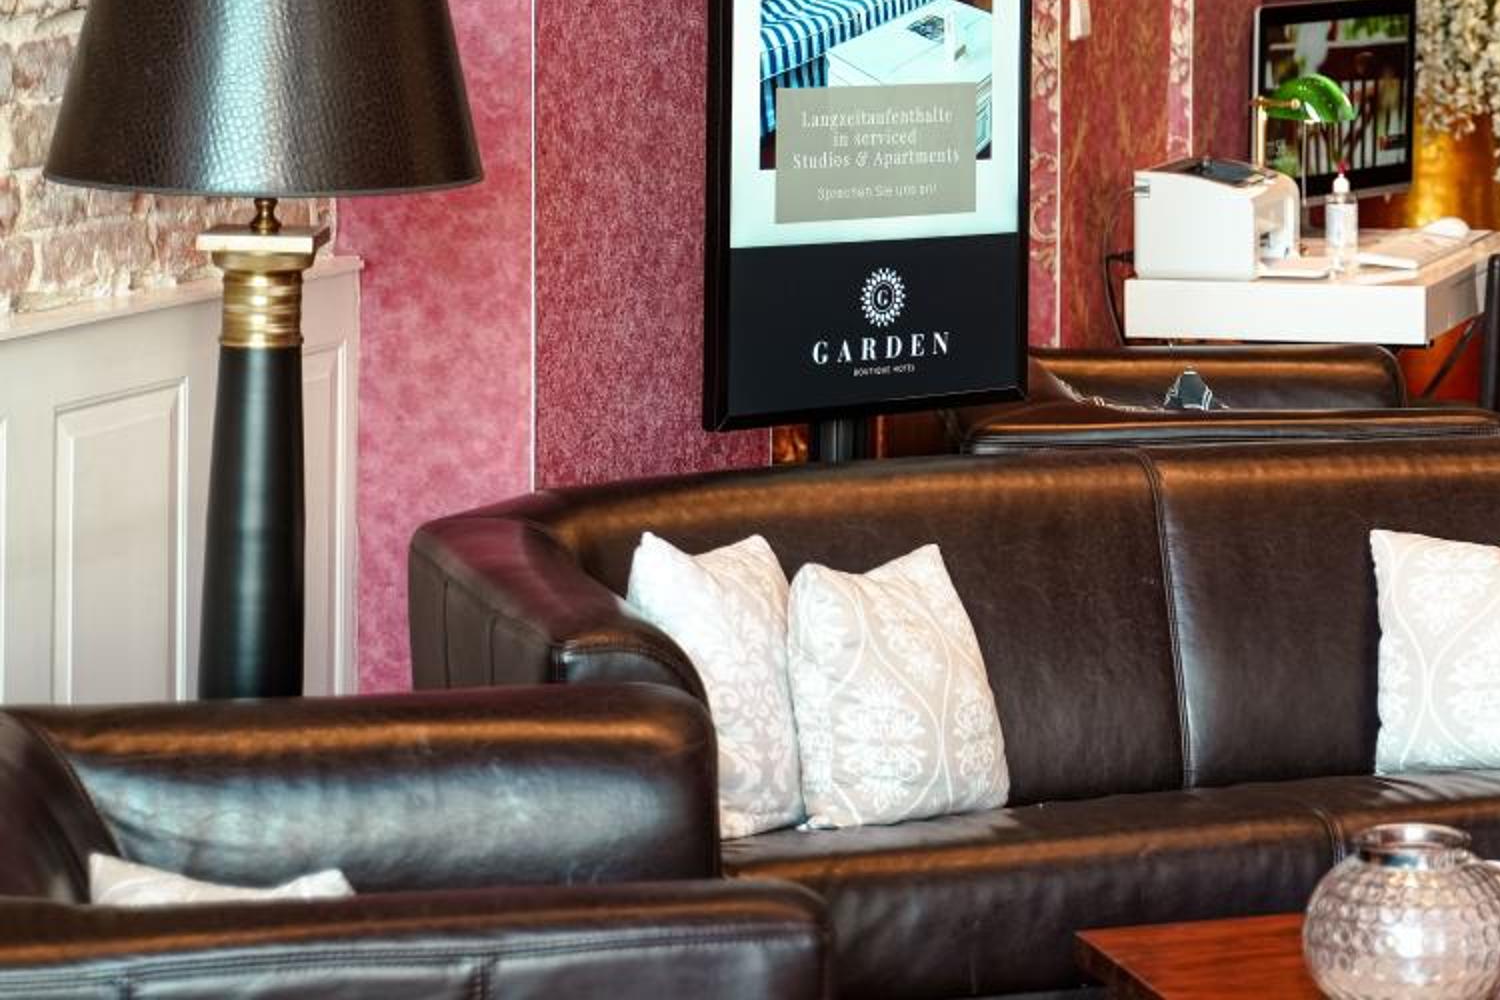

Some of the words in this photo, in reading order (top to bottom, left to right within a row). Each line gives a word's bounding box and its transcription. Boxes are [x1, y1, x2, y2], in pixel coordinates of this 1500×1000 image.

[801, 106, 953, 131] Langzeitaufenthalte
[832, 132, 849, 147] in
[853, 128, 917, 147] serviced
[792, 151, 851, 169] Studios
[855, 151, 868, 168] &
[873, 147, 960, 169] Apartments
[876, 288, 889, 307] G
[812, 331, 950, 365] GARDEN
